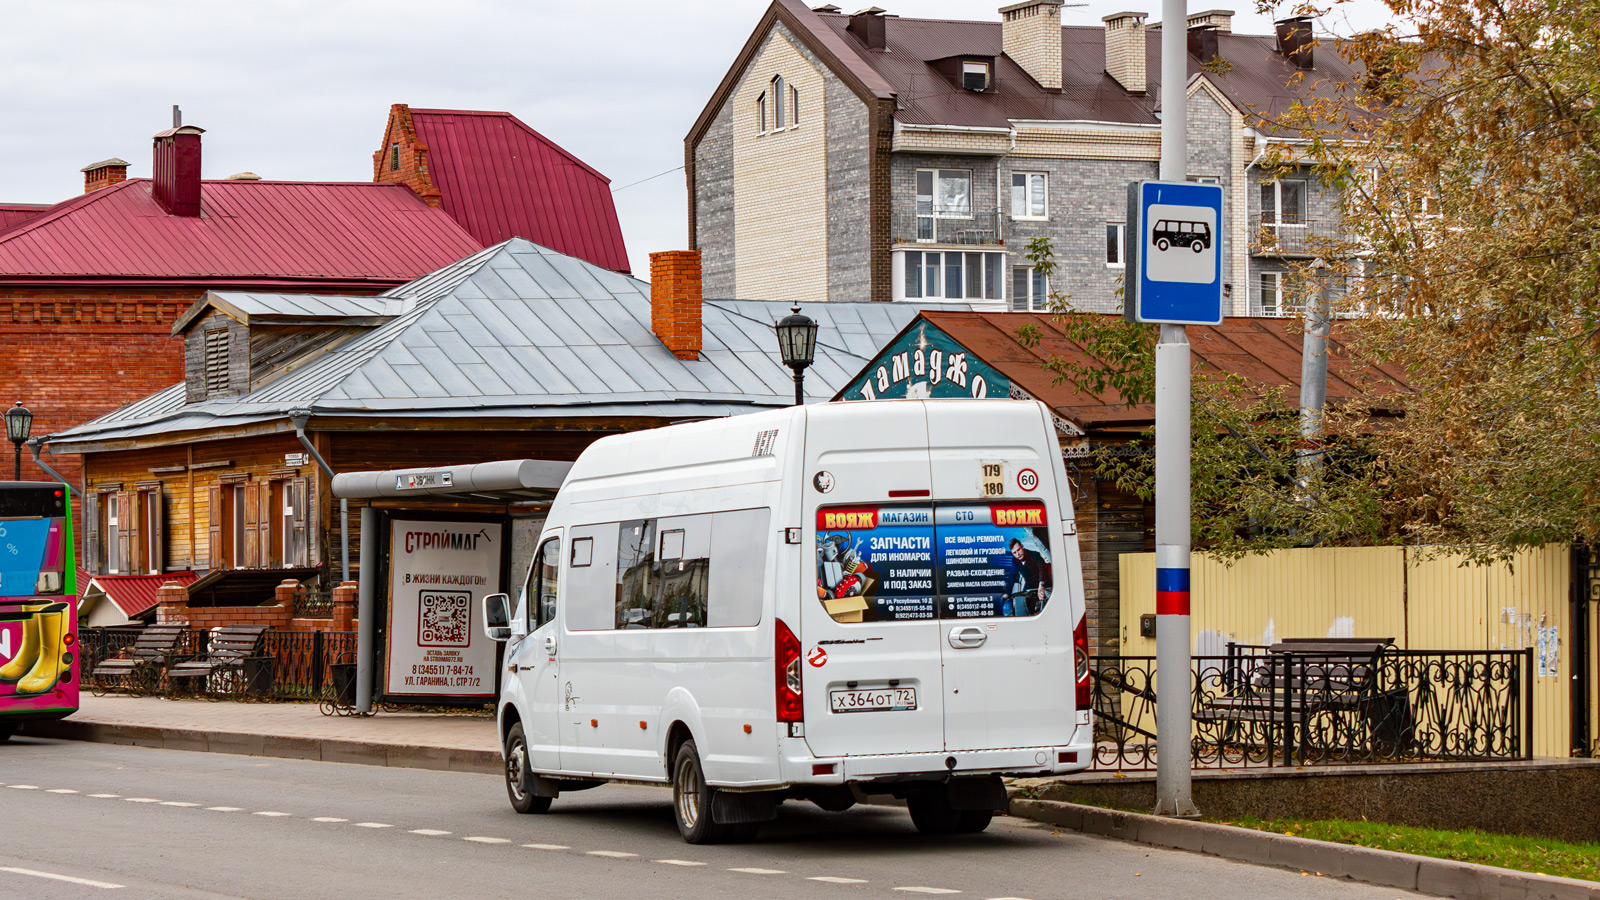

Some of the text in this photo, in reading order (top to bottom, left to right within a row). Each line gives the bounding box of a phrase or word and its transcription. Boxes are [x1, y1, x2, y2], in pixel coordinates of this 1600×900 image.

[752, 429, 779, 456] NEXT
[982, 464, 1000, 476] 179
[1022, 475, 1034, 485] 60
[984, 483, 1003, 494] 180
[825, 512, 928, 528] ВОЯЖ МАГАЗИН
[956, 510, 1042, 525] СТО ВОЯЖ
[405, 529, 481, 554] СТРОЙМАГ
[870, 537, 930, 549] ЗАПЧАСТИ
[957, 536, 975, 544] ВИДЫ
[870, 552, 930, 563] ДЛЯ ИНОМАРОК
[946, 548, 973, 556] ЛЕГКОВОЙ
[890, 569, 932, 578] В НАЛИЧИИ
[946, 569, 1005, 577] РАЗВАЛ-СХОЖДЕНИЕ
[44, 574, 50, 589] 1
[406, 574, 410, 583] В
[412, 574, 440, 584] ЖИЗНИ
[884, 580, 932, 590] И ПОД ЗАКАЗ
[412, 664, 473, 675] 8 (34551) 7-84-74
[405, 676, 415, 686] УЛ.
[456, 678, 467, 686] СТР
[468, 678, 480, 686] 7/2
[896, 690, 910, 700] 72
